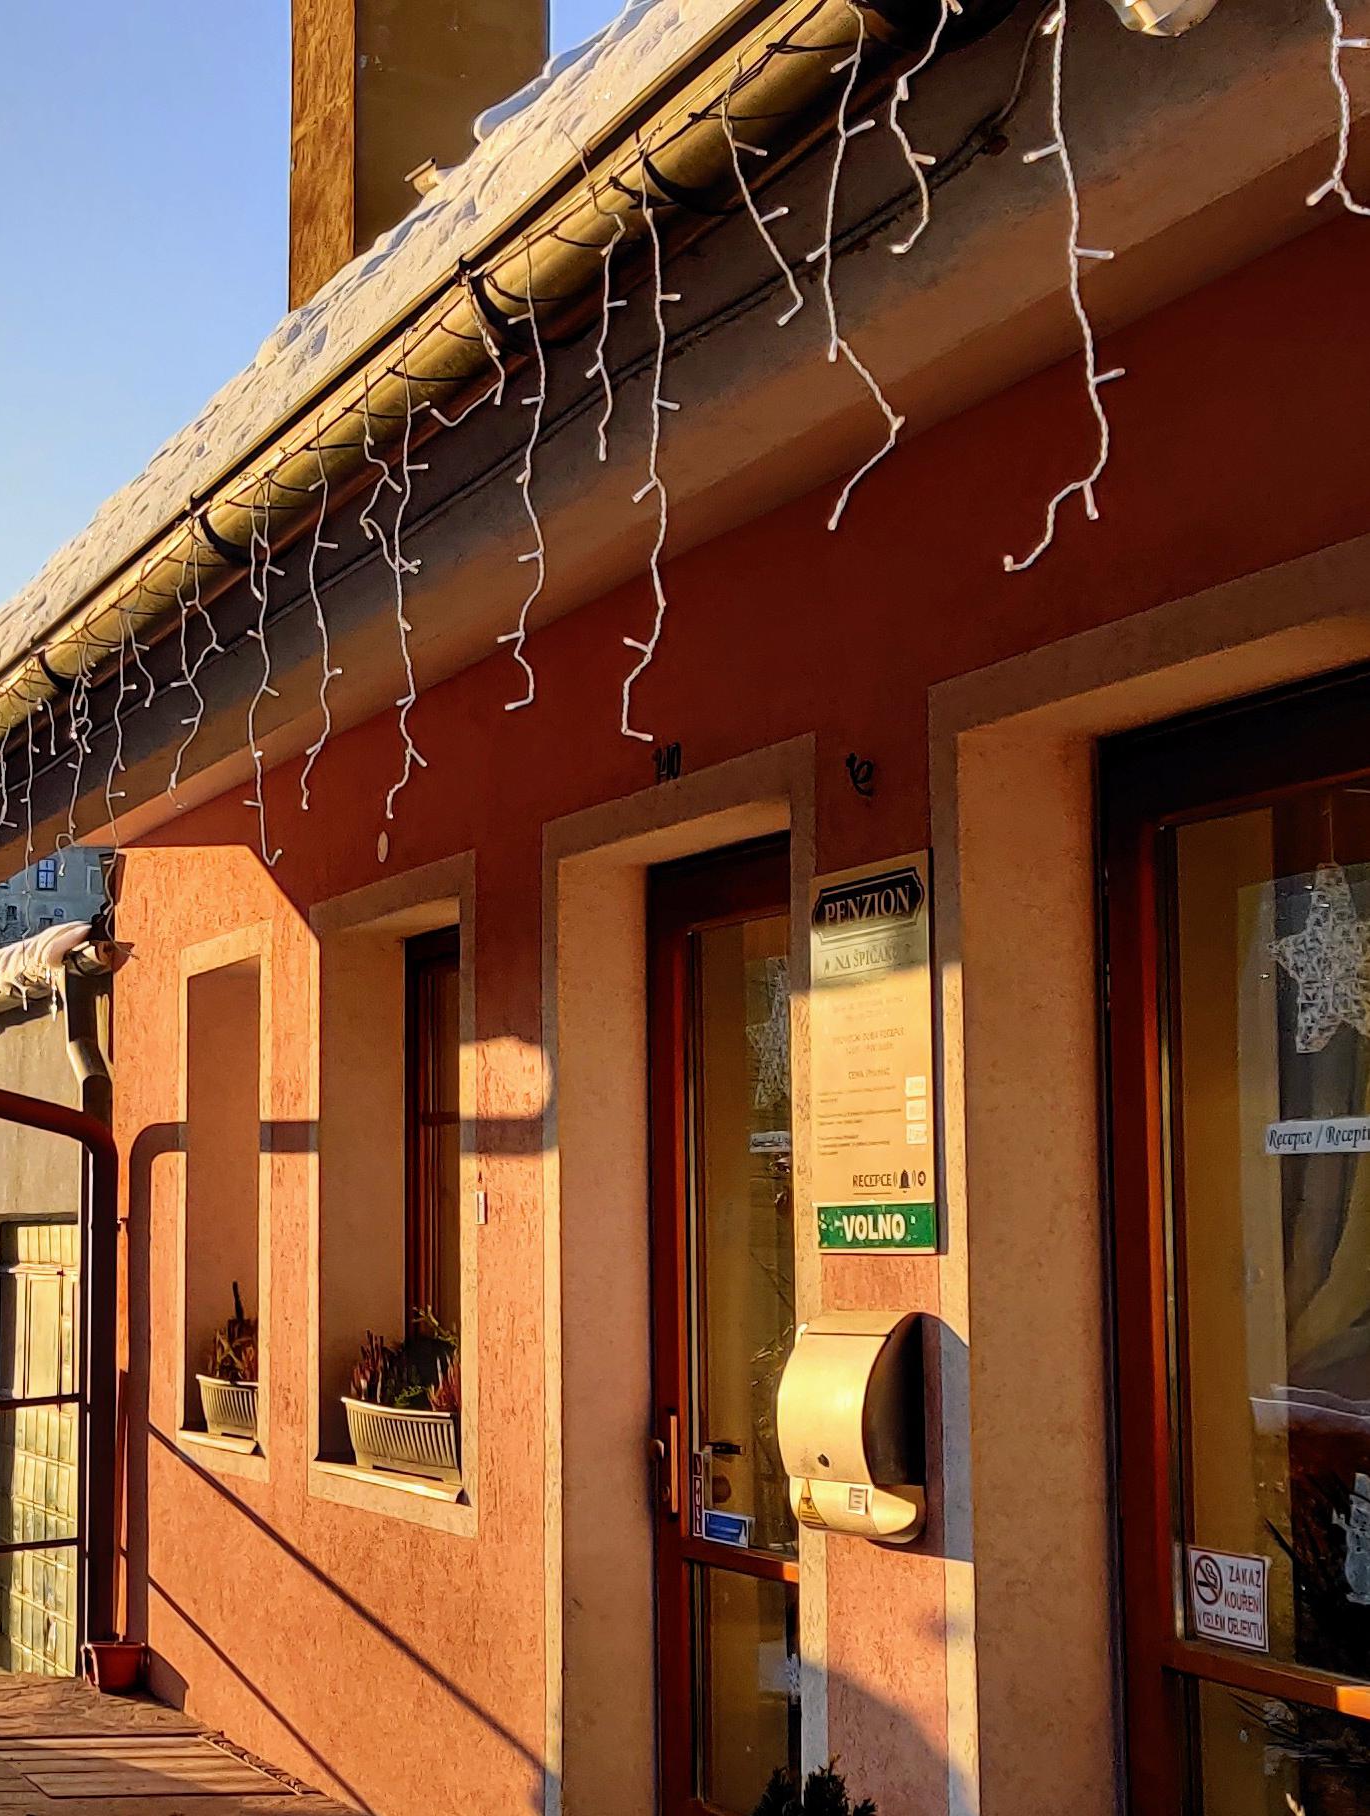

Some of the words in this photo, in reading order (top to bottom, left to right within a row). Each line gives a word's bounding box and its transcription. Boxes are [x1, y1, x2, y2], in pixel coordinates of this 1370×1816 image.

[824, 885, 911, 927] PENZION
[1268, 1129, 1313, 1151] Recepce
[852, 1174, 892, 1187] RECEPCE
[842, 1213, 906, 1242] VOLNO
[1228, 1563, 1262, 1588] ZÁKAZ
[1227, 1616, 1263, 1641] OBJEKTU
